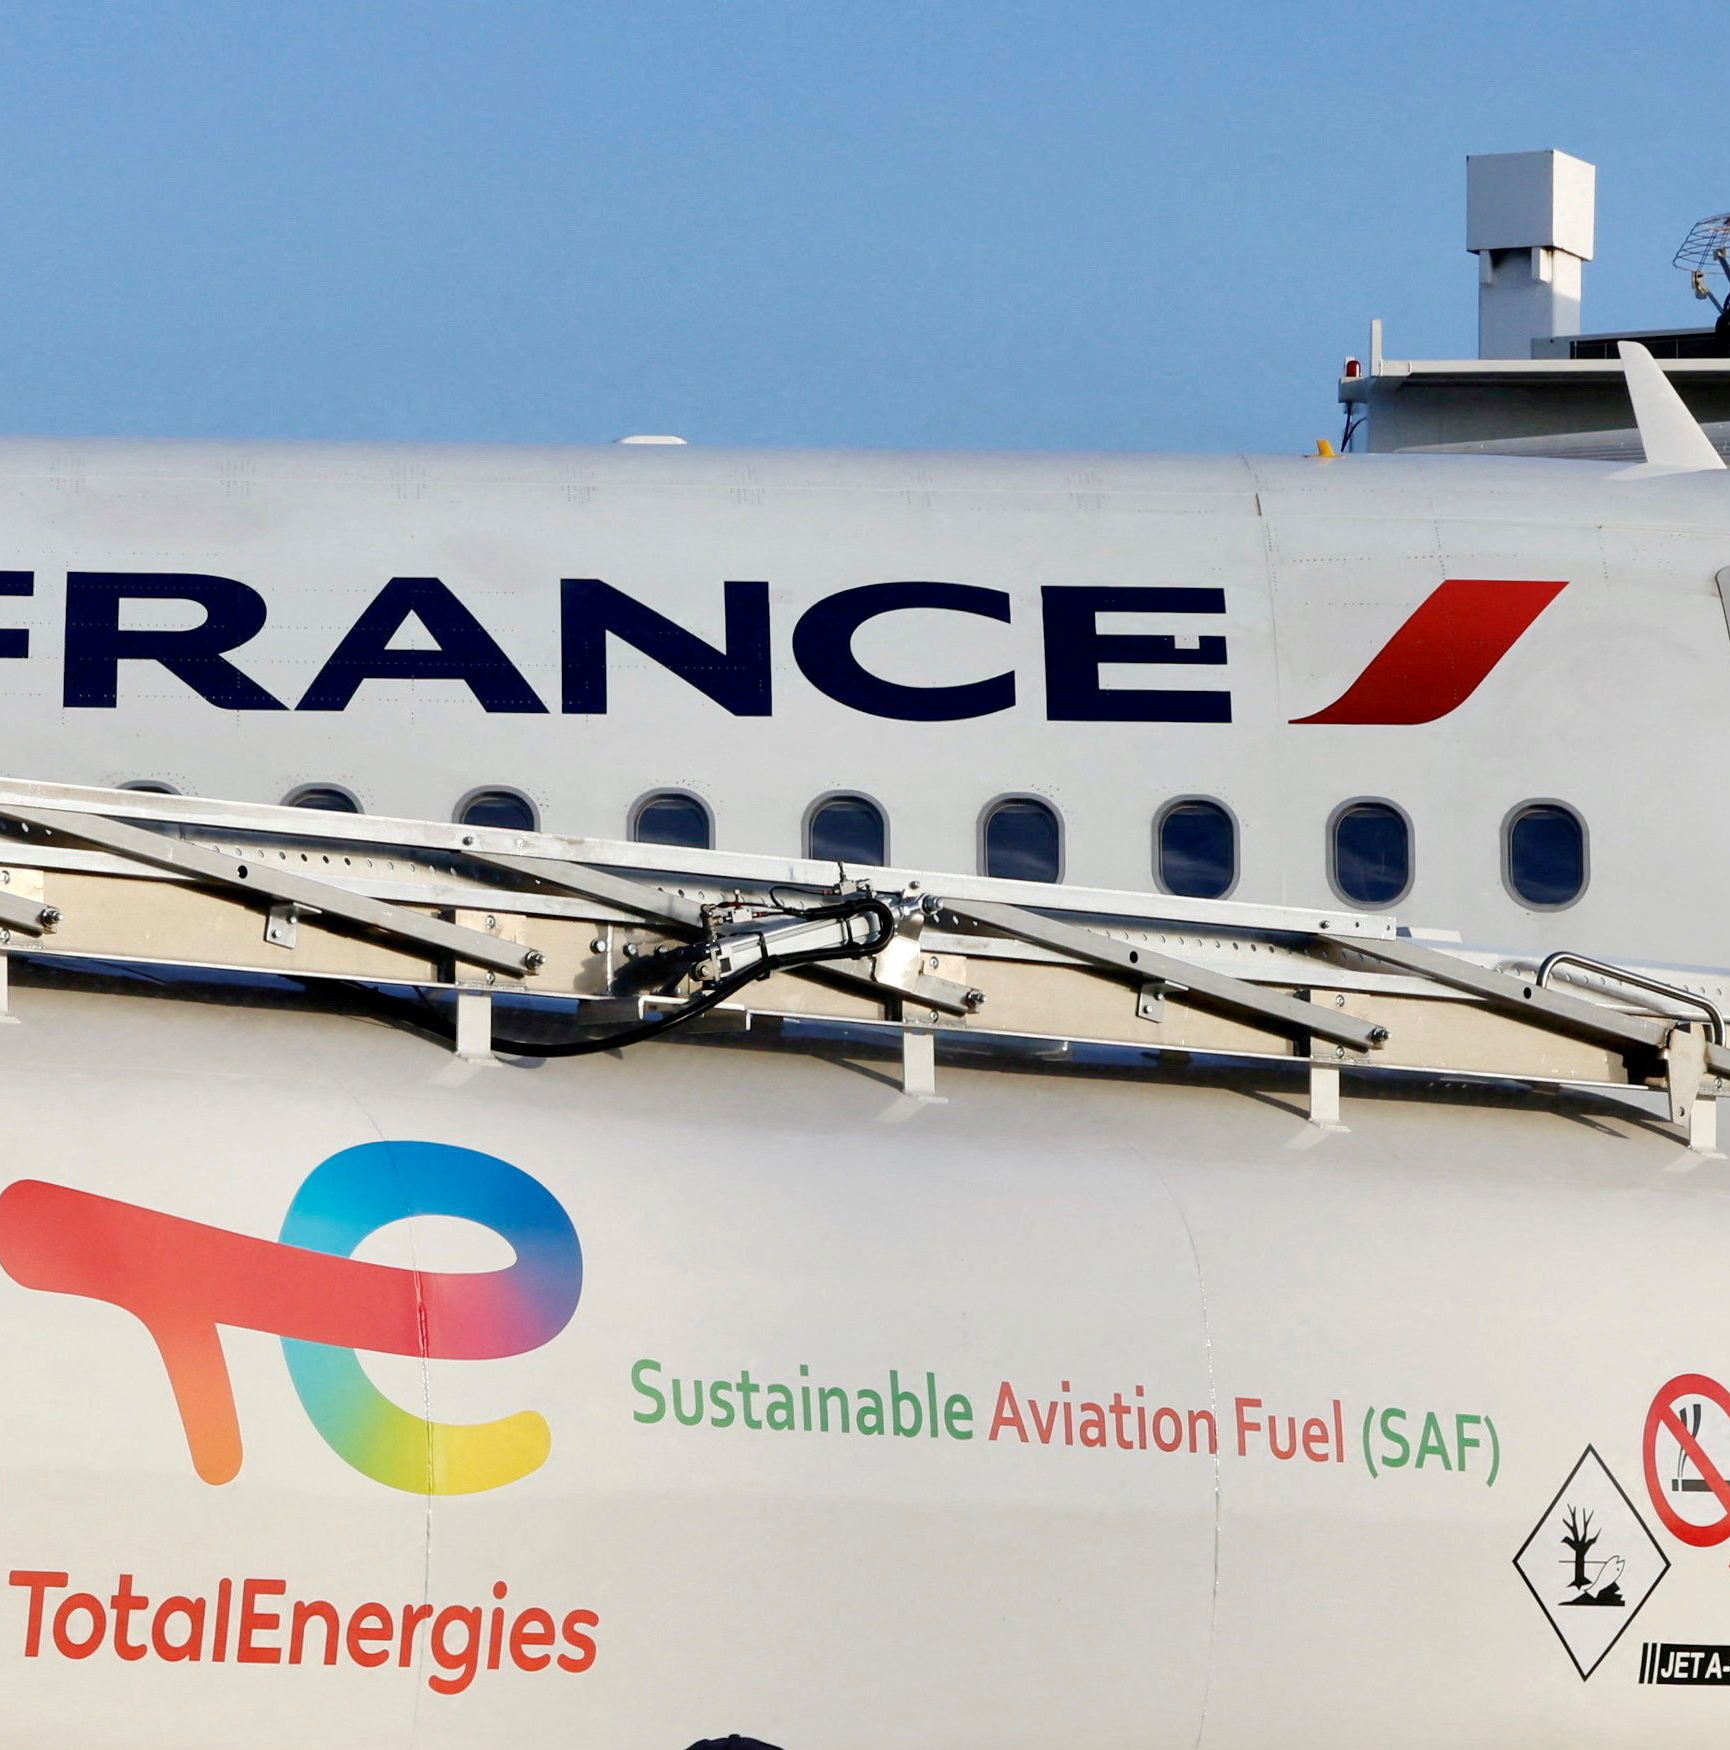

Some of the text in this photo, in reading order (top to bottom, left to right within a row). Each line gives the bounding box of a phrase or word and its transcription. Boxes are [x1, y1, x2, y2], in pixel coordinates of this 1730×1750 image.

[630, 1358, 1501, 1489] Sustainable Aviation Fuel (SAF)
[9, 1569, 599, 1696] TotalEnergies
[1660, 1650, 1704, 1680] JET
